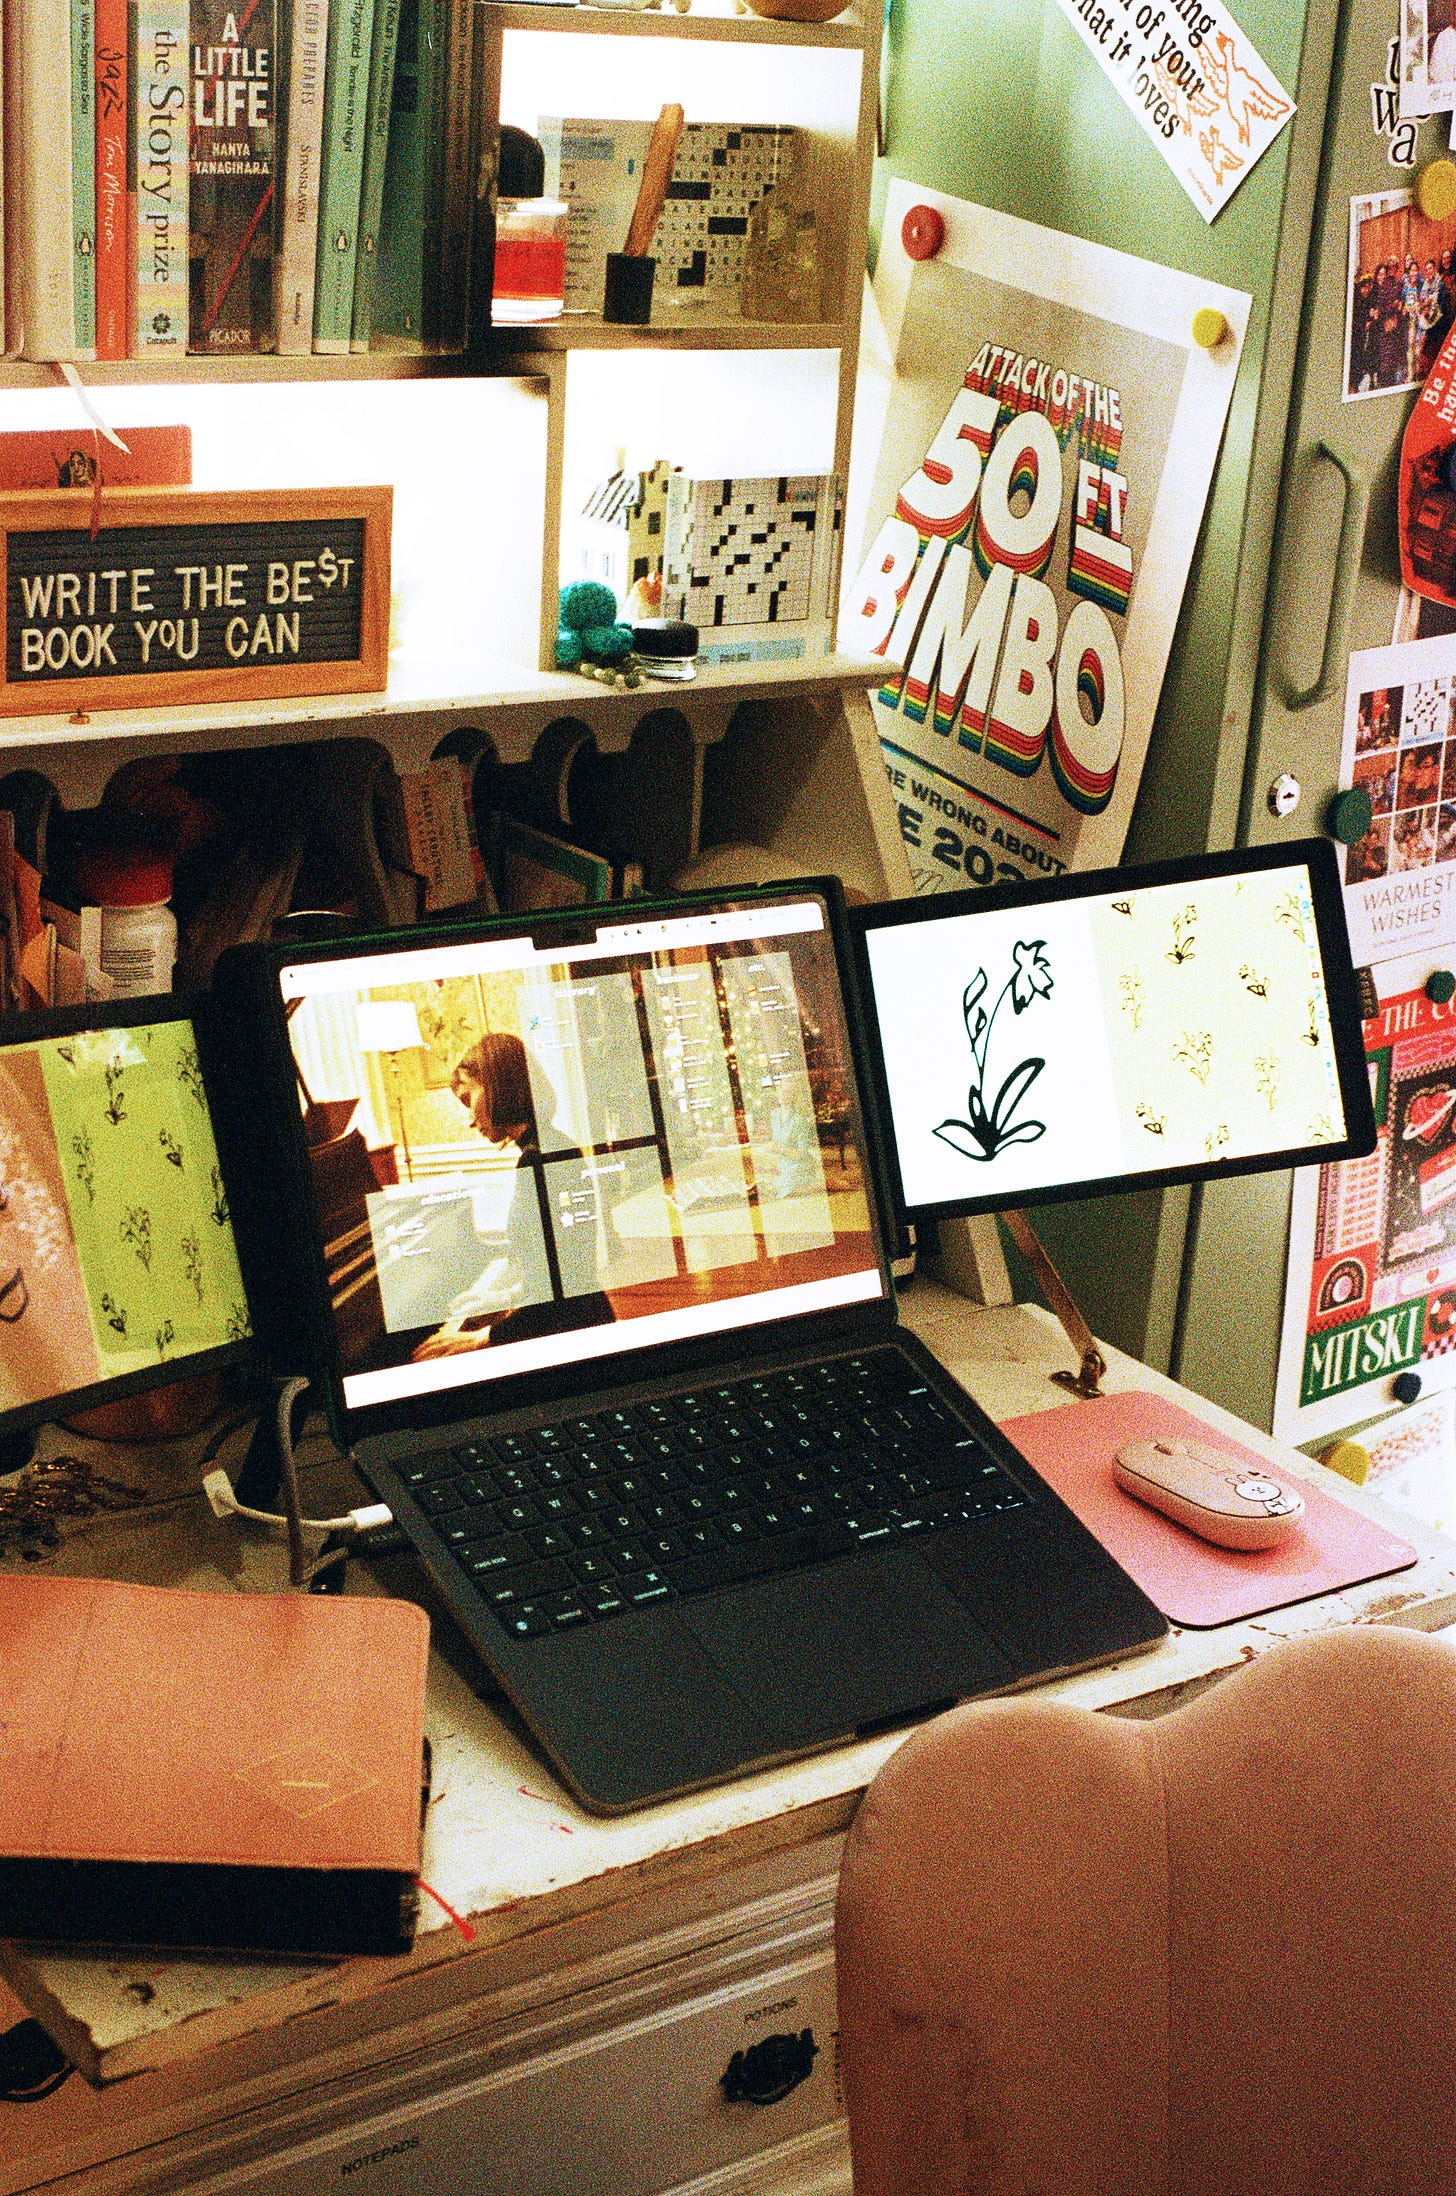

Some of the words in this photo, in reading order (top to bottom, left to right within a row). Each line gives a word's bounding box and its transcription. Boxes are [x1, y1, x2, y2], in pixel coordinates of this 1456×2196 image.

[153, 30, 177, 76] the
[221, 13, 240, 43] A
[1135, 5, 1166, 40] of
[1151, 32, 1205, 101] your
[194, 46, 269, 78] LITTLE
[194, 80, 270, 129] LIFE
[141, 83, 184, 203] Story
[195, 161, 270, 175] YANAGIHARA
[212, 142, 251, 157] HANYA
[103, 171, 122, 255] Morrison
[146, 213, 177, 284] prize
[965, 340, 1051, 400] ATTACK
[1051, 368, 1080, 411] OF
[1081, 377, 1124, 432] THE
[1422, 376, 1447, 406] Be
[898, 385, 1064, 558] 50
[1074, 457, 1129, 540] FT
[20, 567, 155, 620] WRITE
[174, 563, 249, 611] THE
[20, 622, 117, 673] BOOK
[225, 611, 301, 660] CAN
[835, 515, 1127, 778] BIMBO
[910, 778, 989, 838] WRONG
[990, 826, 1068, 876] ABOUT
[1363, 871, 1455, 912] WARMEST
[1370, 899, 1442, 933] WISHES
[1379, 998, 1427, 1037] THE
[1306, 1305, 1421, 1396] MITSKI
[340, 2134, 421, 2178] NOTEPADS
